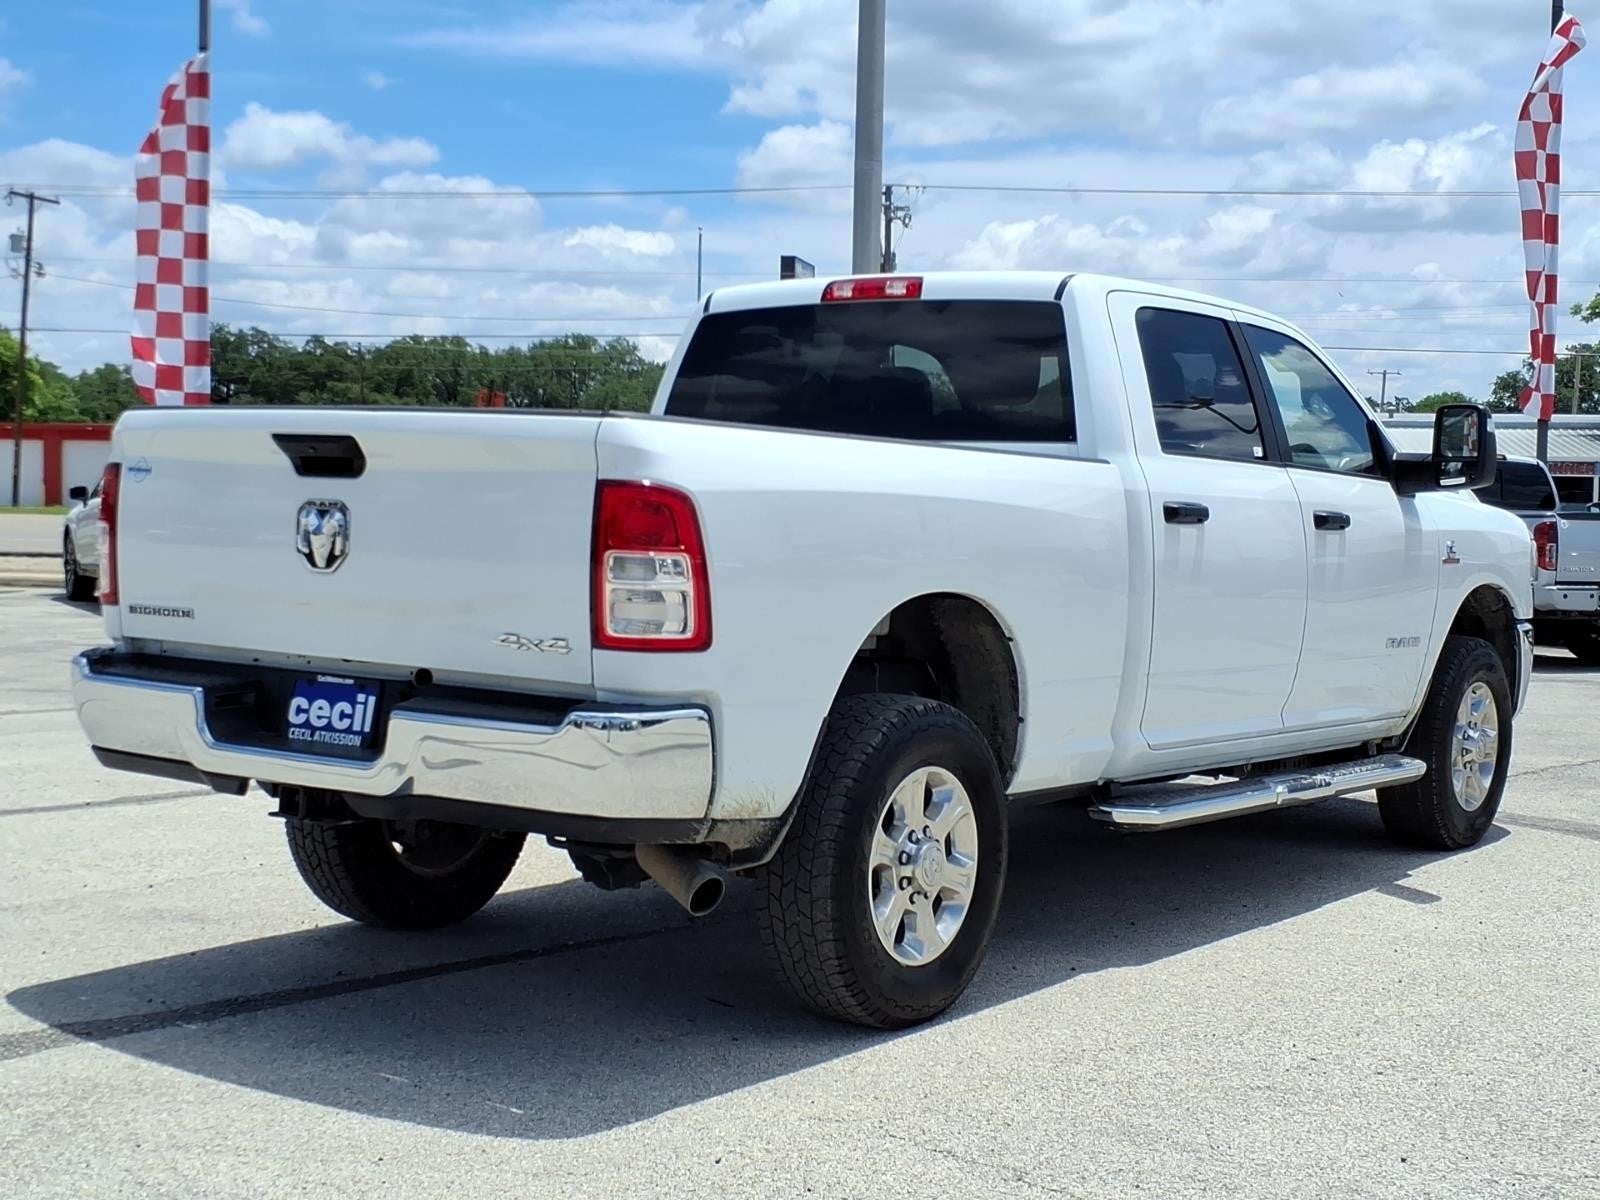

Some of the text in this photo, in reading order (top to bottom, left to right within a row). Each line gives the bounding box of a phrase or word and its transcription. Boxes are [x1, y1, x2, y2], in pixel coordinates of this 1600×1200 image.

[129, 605, 194, 619] BIGHORN
[288, 693, 376, 732] cecil
[288, 727, 361, 747] CECIL ATKISSION
